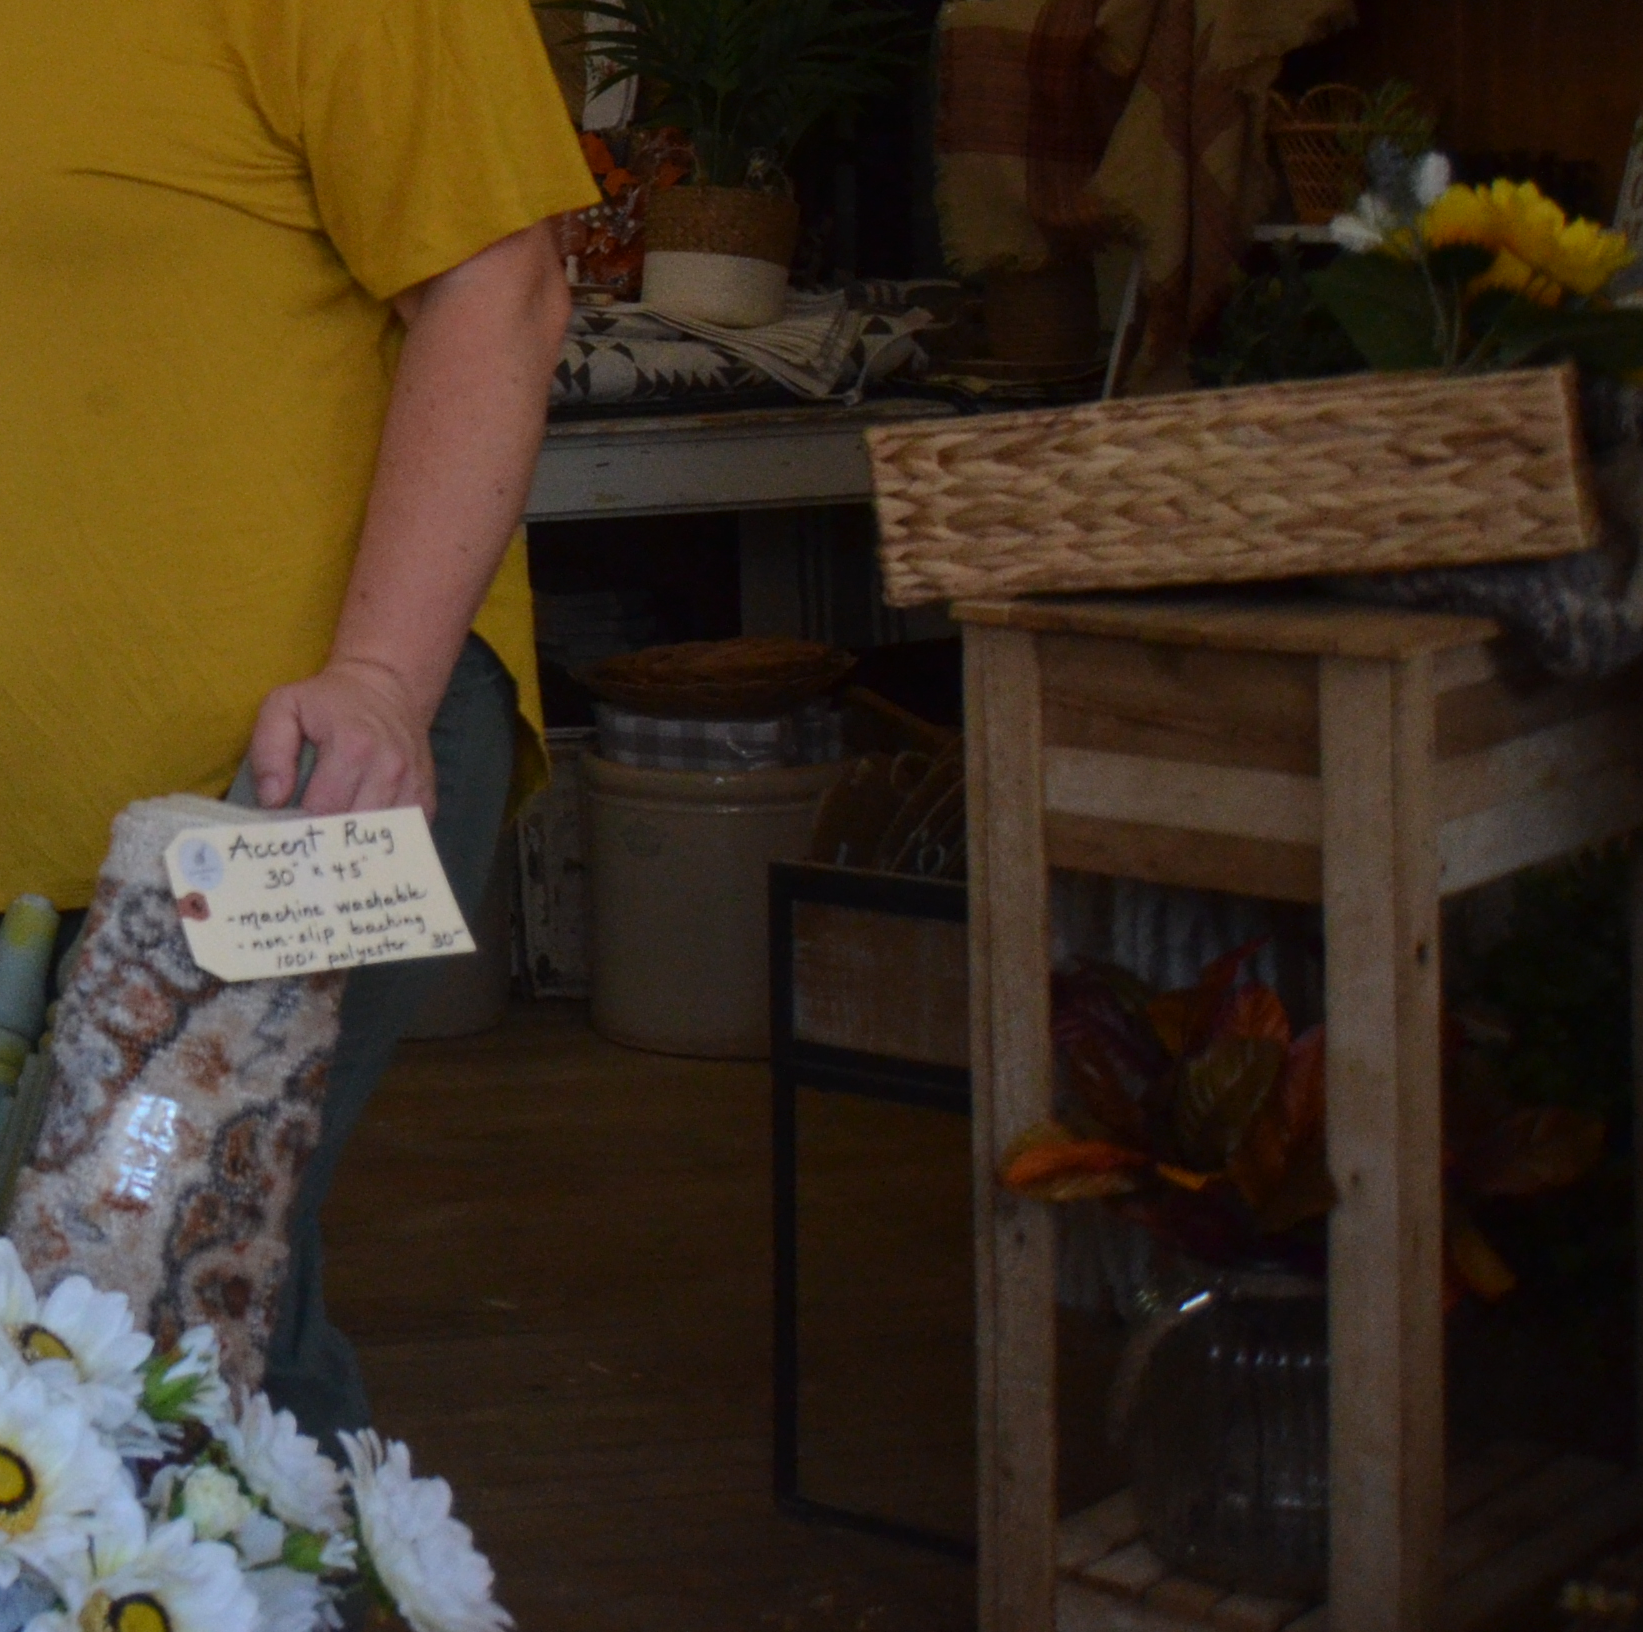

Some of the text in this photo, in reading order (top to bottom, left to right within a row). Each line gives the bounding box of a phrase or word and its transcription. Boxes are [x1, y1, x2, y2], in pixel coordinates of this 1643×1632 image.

[228, 820, 395, 860] Accent Rug
[328, 935, 406, 967] polyester
